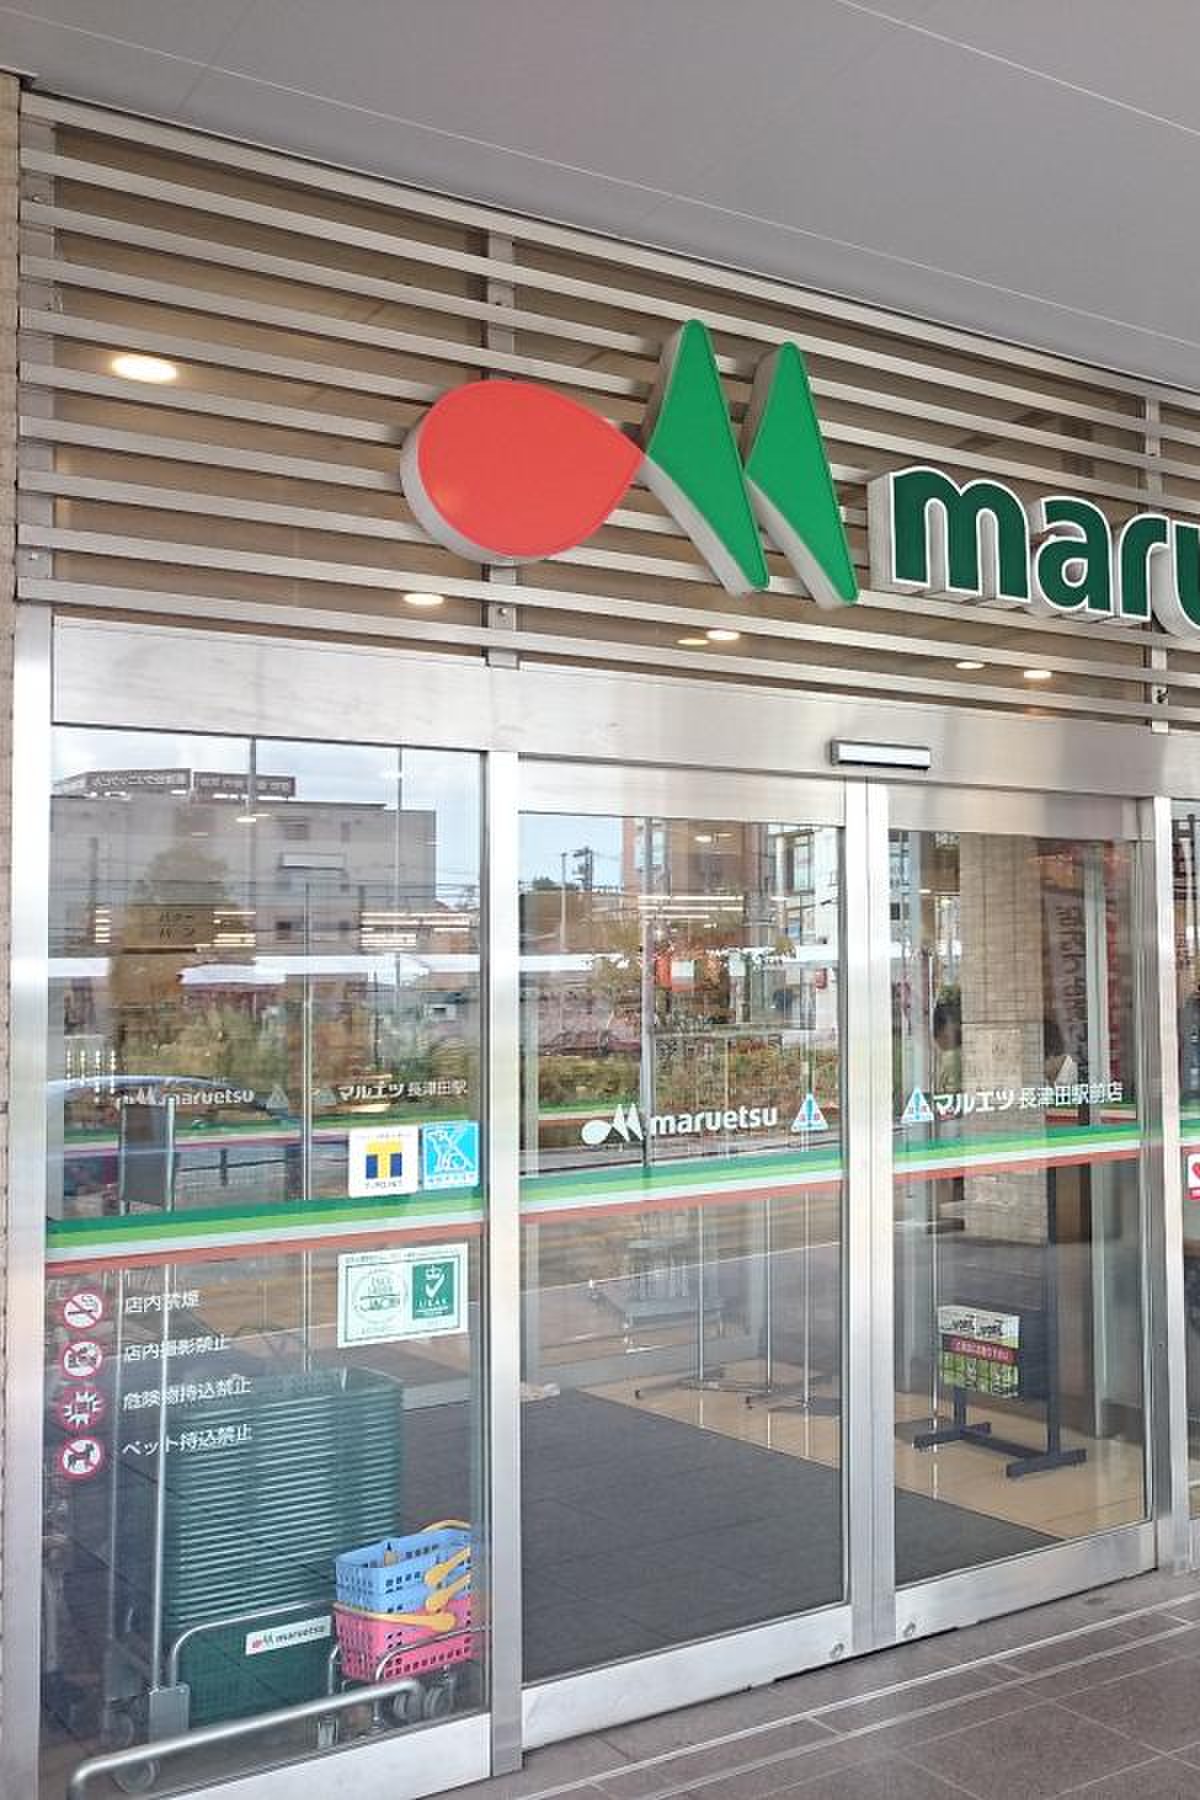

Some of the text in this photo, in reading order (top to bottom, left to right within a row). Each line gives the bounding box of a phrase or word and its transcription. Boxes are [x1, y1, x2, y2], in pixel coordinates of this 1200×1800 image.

[933, 1087, 1015, 1116] マルエツ
[651, 1105, 778, 1136] maruetsu
[125, 1289, 200, 1313] 店内禁煙
